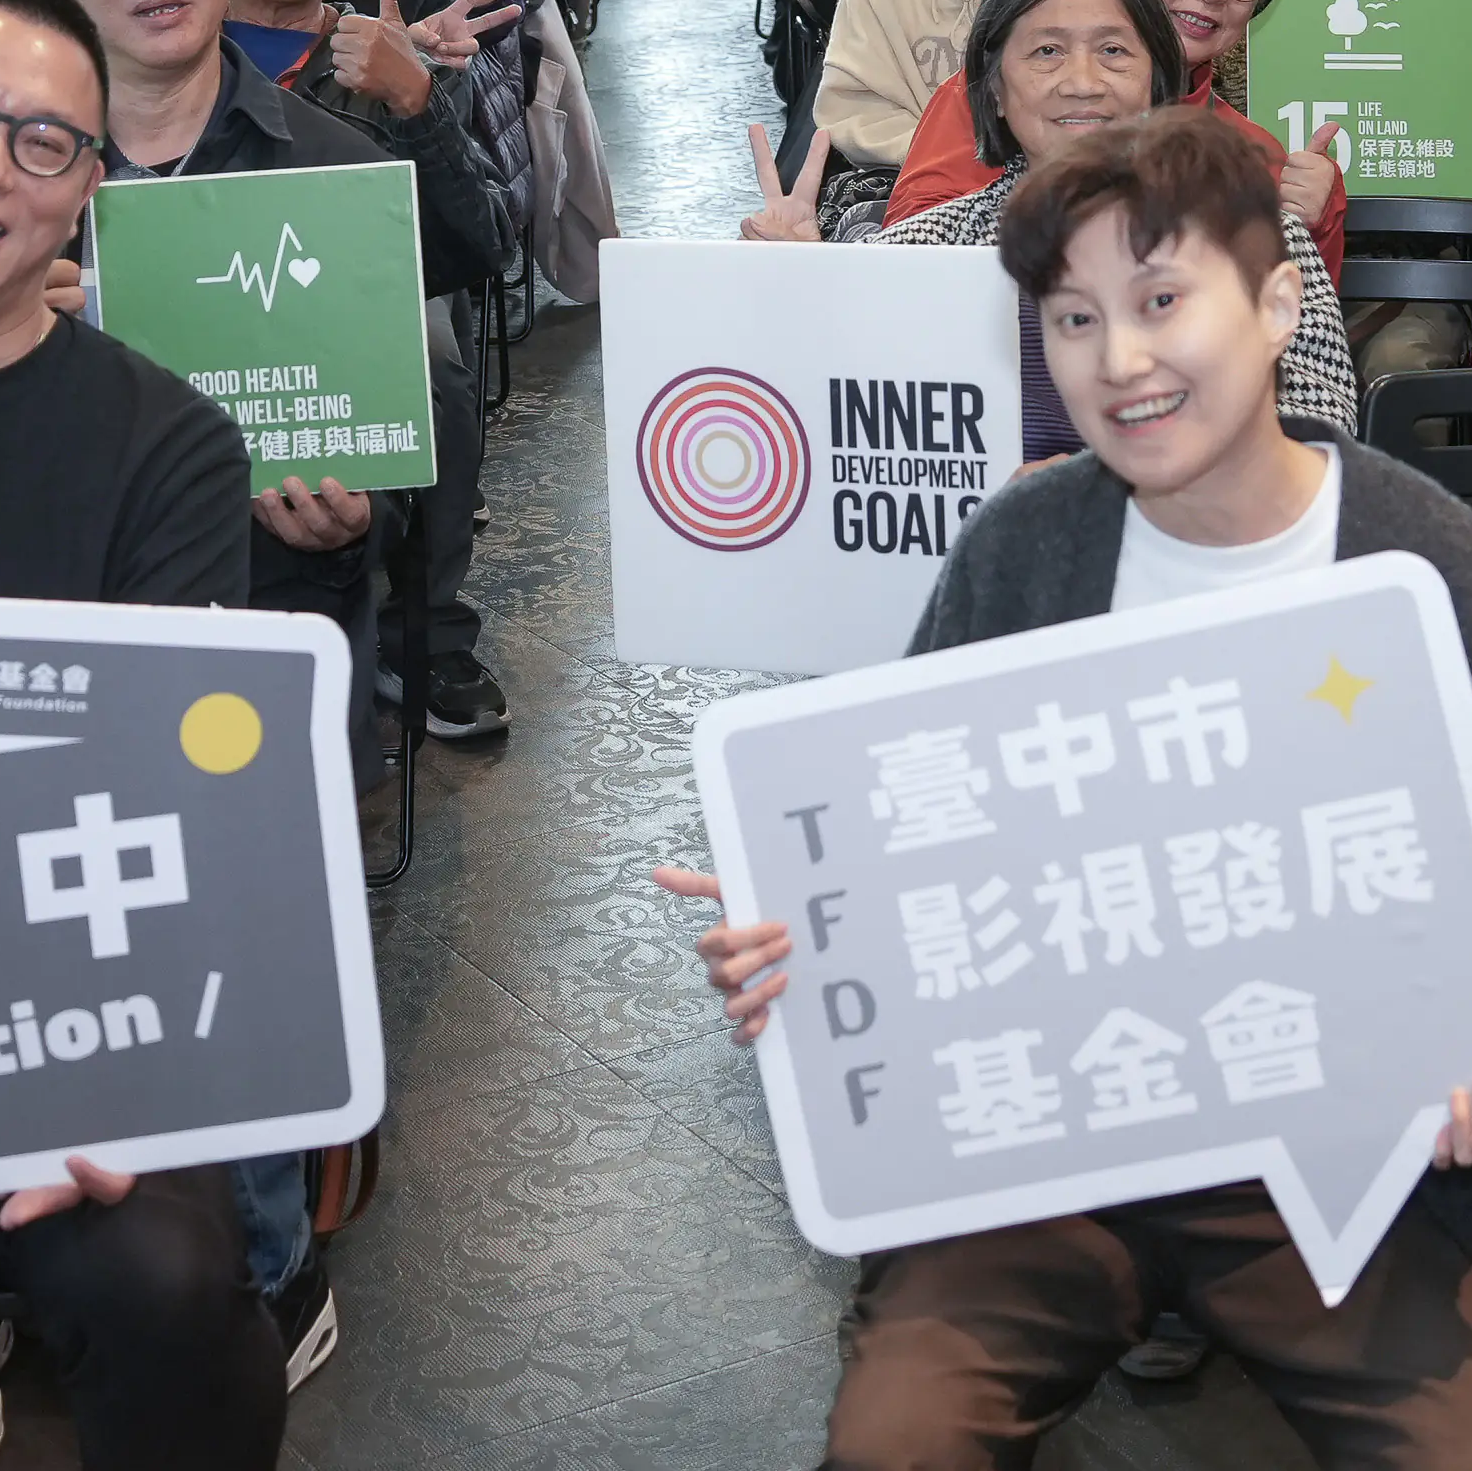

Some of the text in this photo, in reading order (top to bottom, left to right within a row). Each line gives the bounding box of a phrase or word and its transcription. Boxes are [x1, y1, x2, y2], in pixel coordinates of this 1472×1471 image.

[1357, 101, 1382, 117] LIFE
[1278, 101, 1352, 177] 15
[1357, 120, 1408, 136] ON LAND
[1358, 159, 1436, 179] 生態領地
[188, 364, 318, 397] GOOD HEALTH
[235, 393, 352, 426] WELL-BEING
[829, 377, 987, 454] INNER
[832, 454, 988, 490] DEVELOPMENT
[866, 676, 1253, 856] 臺中市
[897, 786, 1435, 1001] 影視發展
[932, 978, 1326, 1159] 基金會
